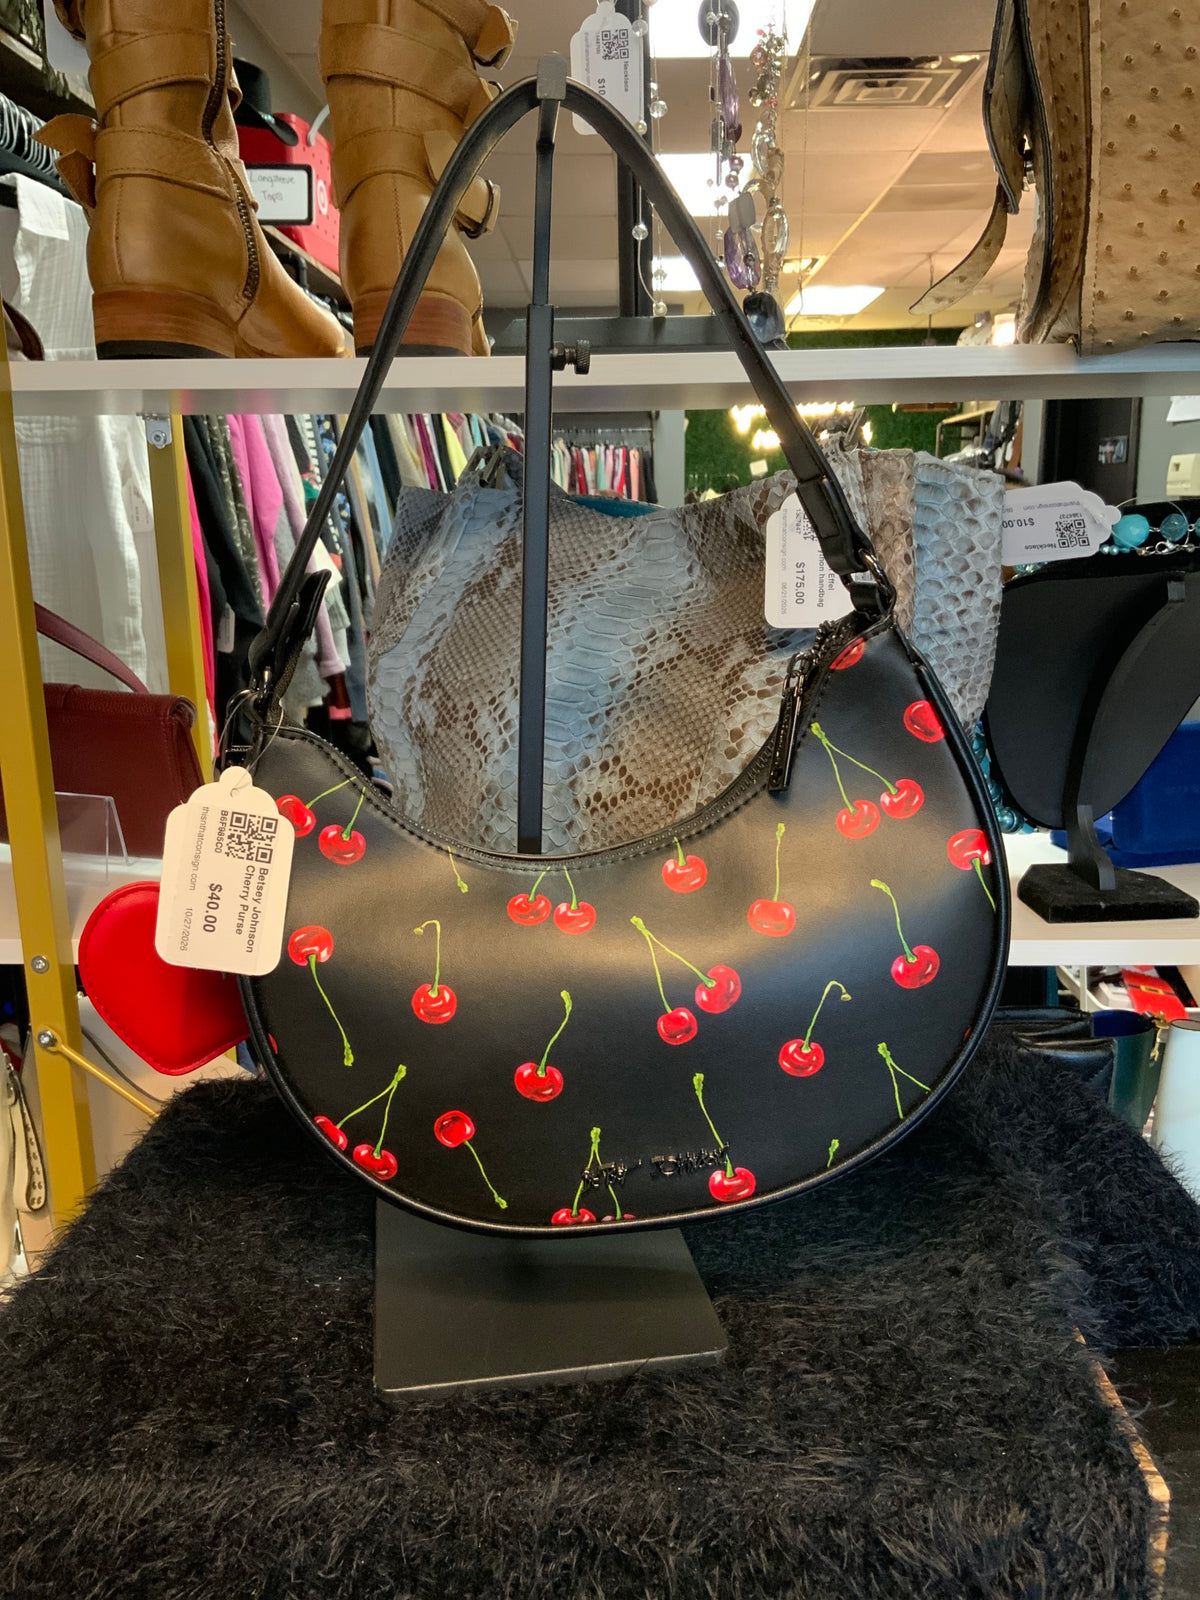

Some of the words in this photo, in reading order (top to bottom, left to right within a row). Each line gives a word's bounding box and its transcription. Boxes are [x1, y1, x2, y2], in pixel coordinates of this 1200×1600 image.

[260, 190, 284, 203] Tops
[1001, 517, 1035, 529] $10.00
[817, 549, 826, 572] ython
[795, 561, 806, 605] $175.00
[816, 573, 826, 608] handbag
[827, 573, 836, 591] Effel
[190, 806, 209, 891] thisnthatconsign.com
[214, 809, 229, 854] B6F985C0
[239, 865, 256, 901] Cherry
[252, 867, 269, 905] Betsey
[203, 883, 223, 933] $40.00
[235, 904, 250, 935] Purse
[179, 907, 193, 952] 10/27/2026
[245, 906, 262, 953] Johnson
